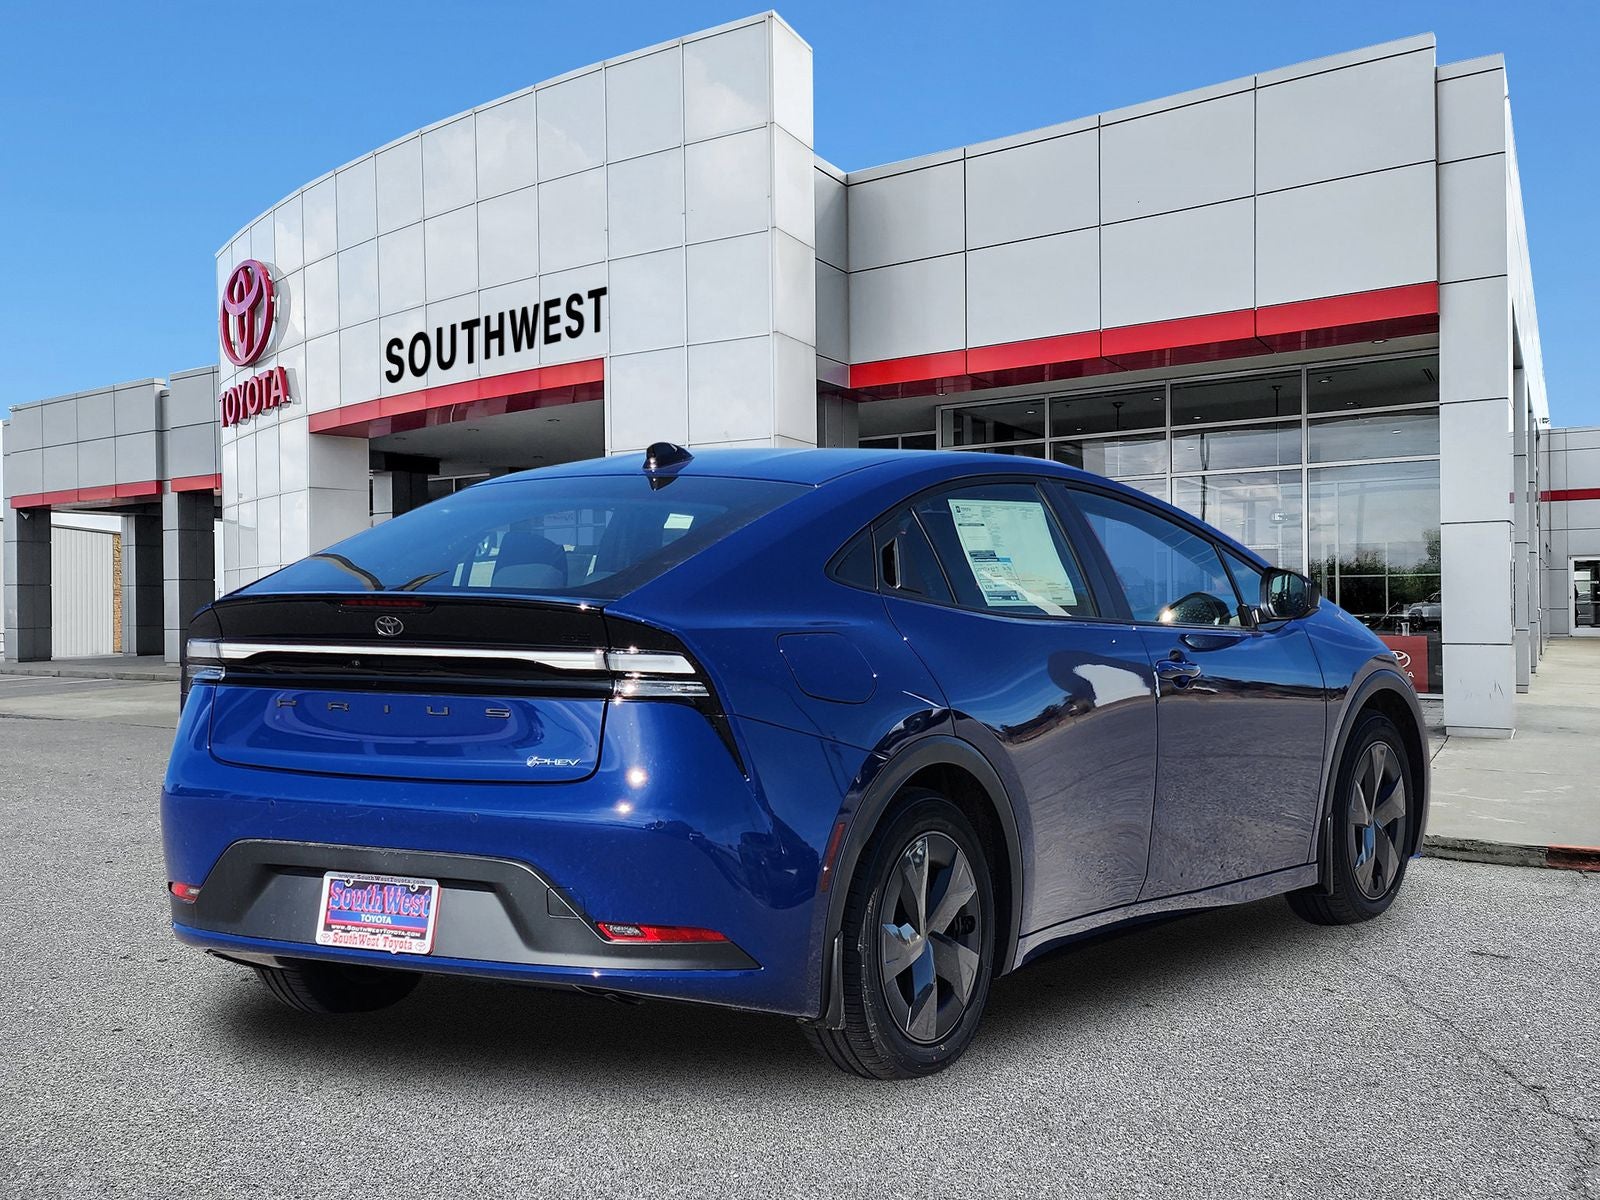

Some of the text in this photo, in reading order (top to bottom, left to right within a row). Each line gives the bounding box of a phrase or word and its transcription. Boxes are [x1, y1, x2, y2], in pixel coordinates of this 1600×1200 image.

[386, 286, 608, 384] SOUTHWEST
[219, 366, 291, 428] TOYOTA
[277, 699, 512, 718] PRIUS
[536, 757, 581, 767] PHEV
[360, 913, 392, 924] TOYOTA
[383, 936, 413, 951] Toyota
